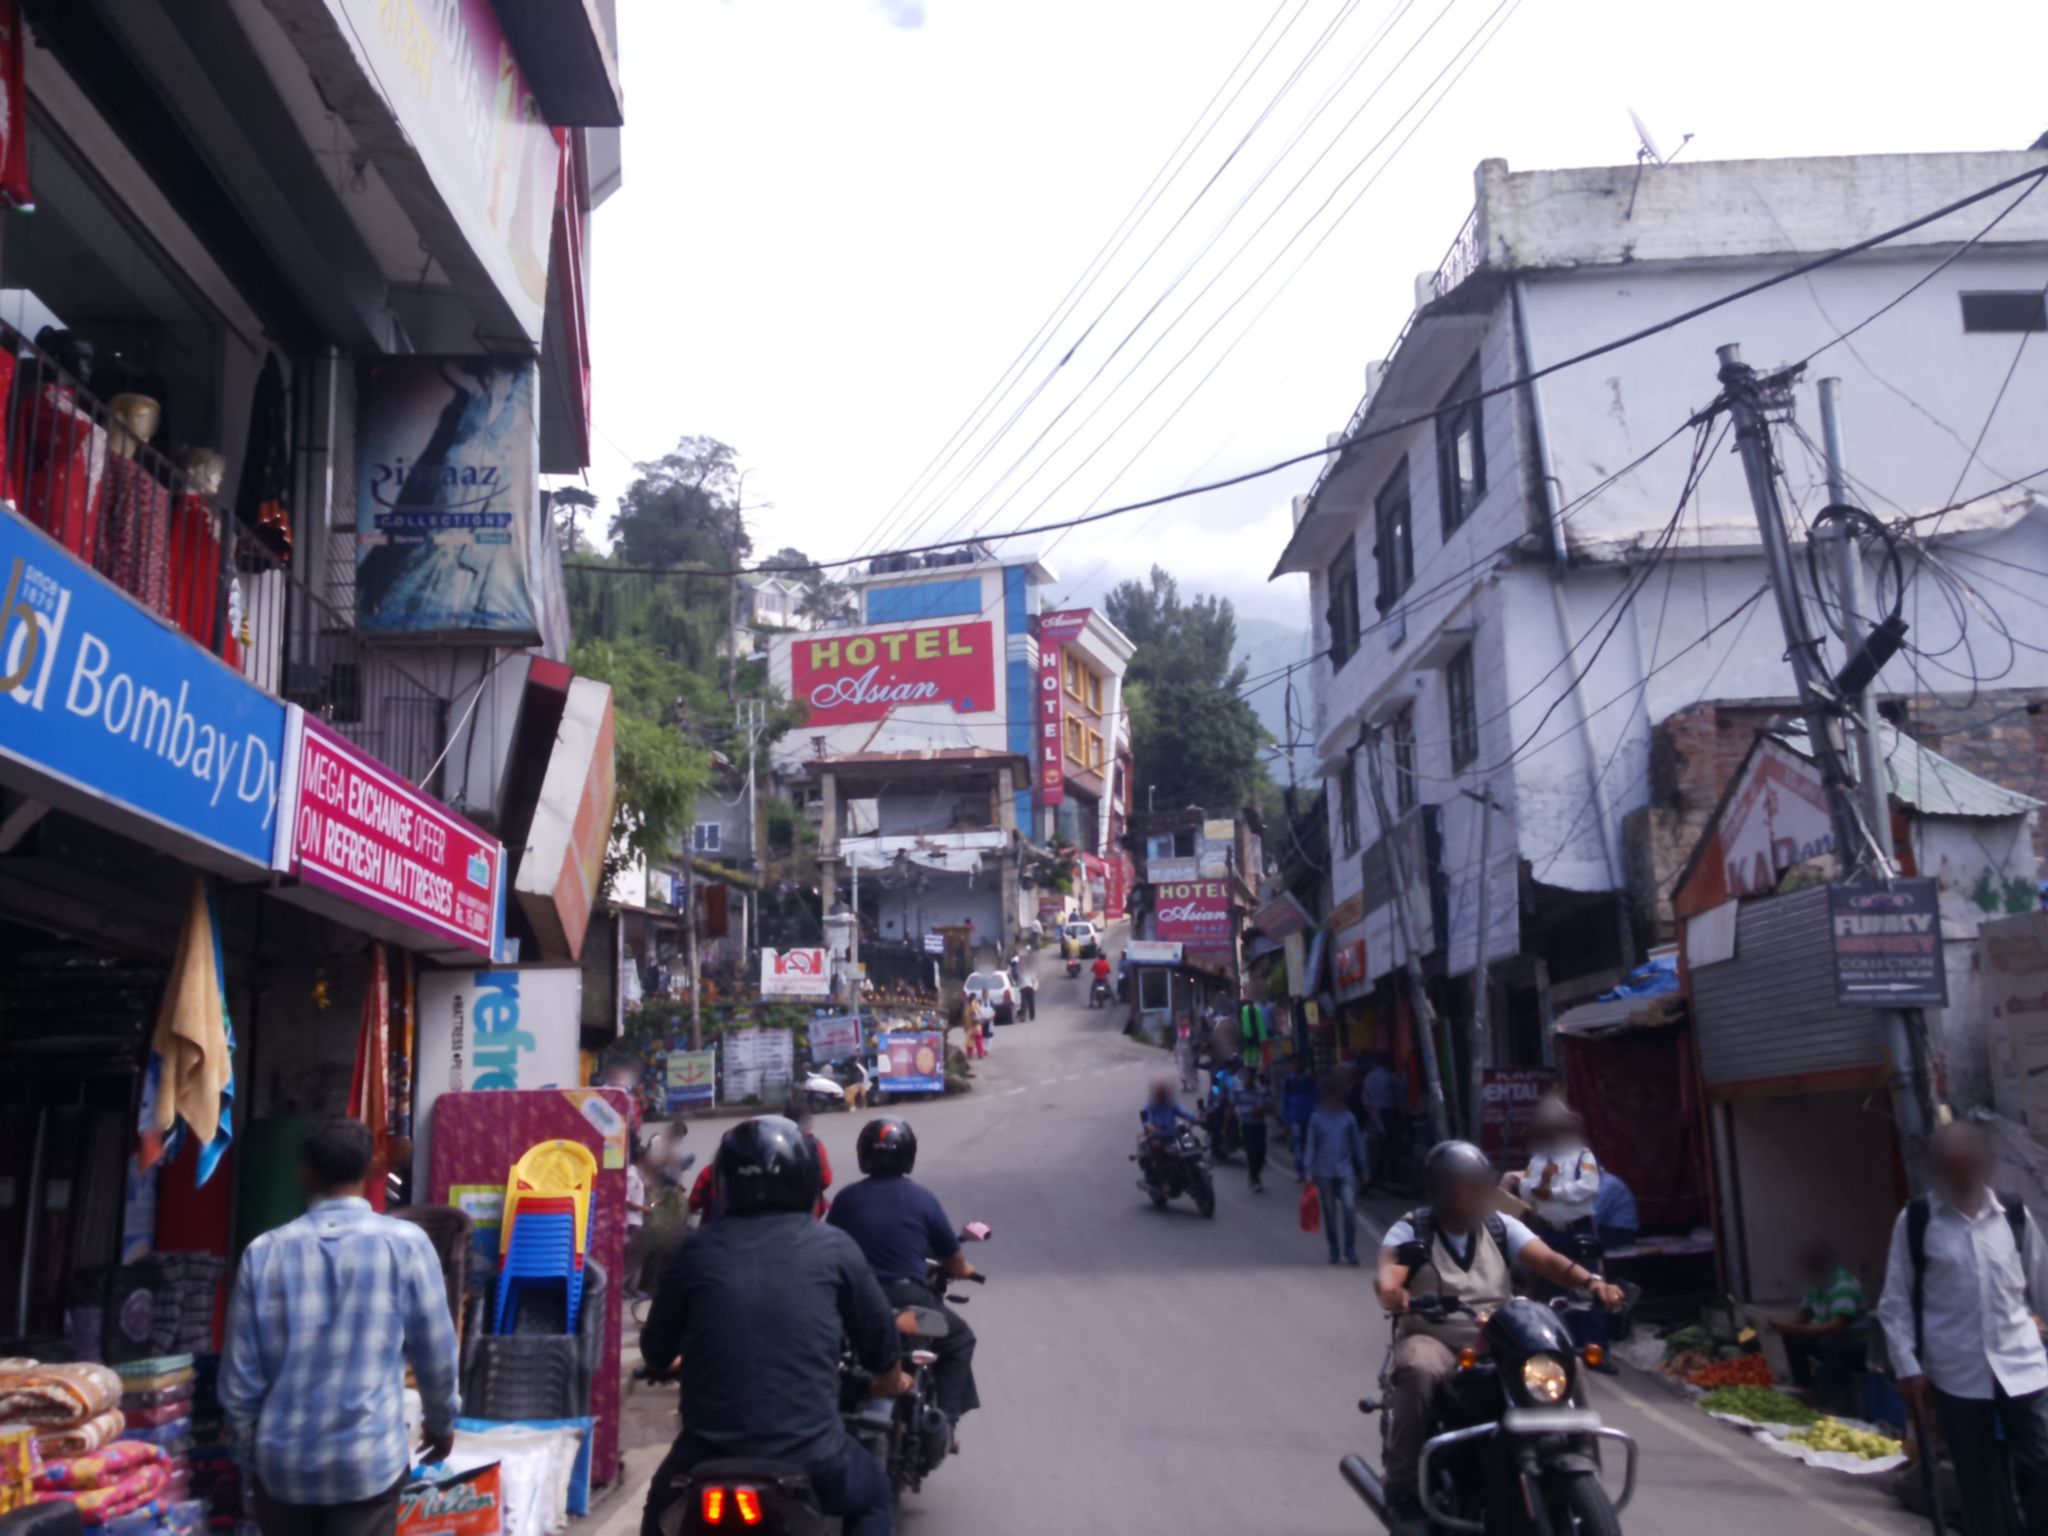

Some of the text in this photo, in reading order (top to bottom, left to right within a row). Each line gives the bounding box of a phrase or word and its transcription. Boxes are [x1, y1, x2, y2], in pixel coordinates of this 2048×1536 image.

[22, 583, 55, 612] 1879
[810, 628, 974, 671] HOTEL
[810, 664, 940, 709] Asian
[65, 632, 238, 807] Bombay
[1042, 653, 1058, 762] HOTEL
[305, 747, 447, 866] MEGA EXCHANGE OFFER
[300, 805, 323, 856] ON
[323, 817, 383, 885] REFRESH
[383, 849, 454, 918] MATTRESSES
[1159, 884, 1230, 899] HOTEL
[1158, 901, 1227, 922] Asian
[1834, 913, 1932, 937] FUNKY
[1838, 957, 1934, 970] COLLECTION
[1482, 1083, 1541, 1101] ENTAL
